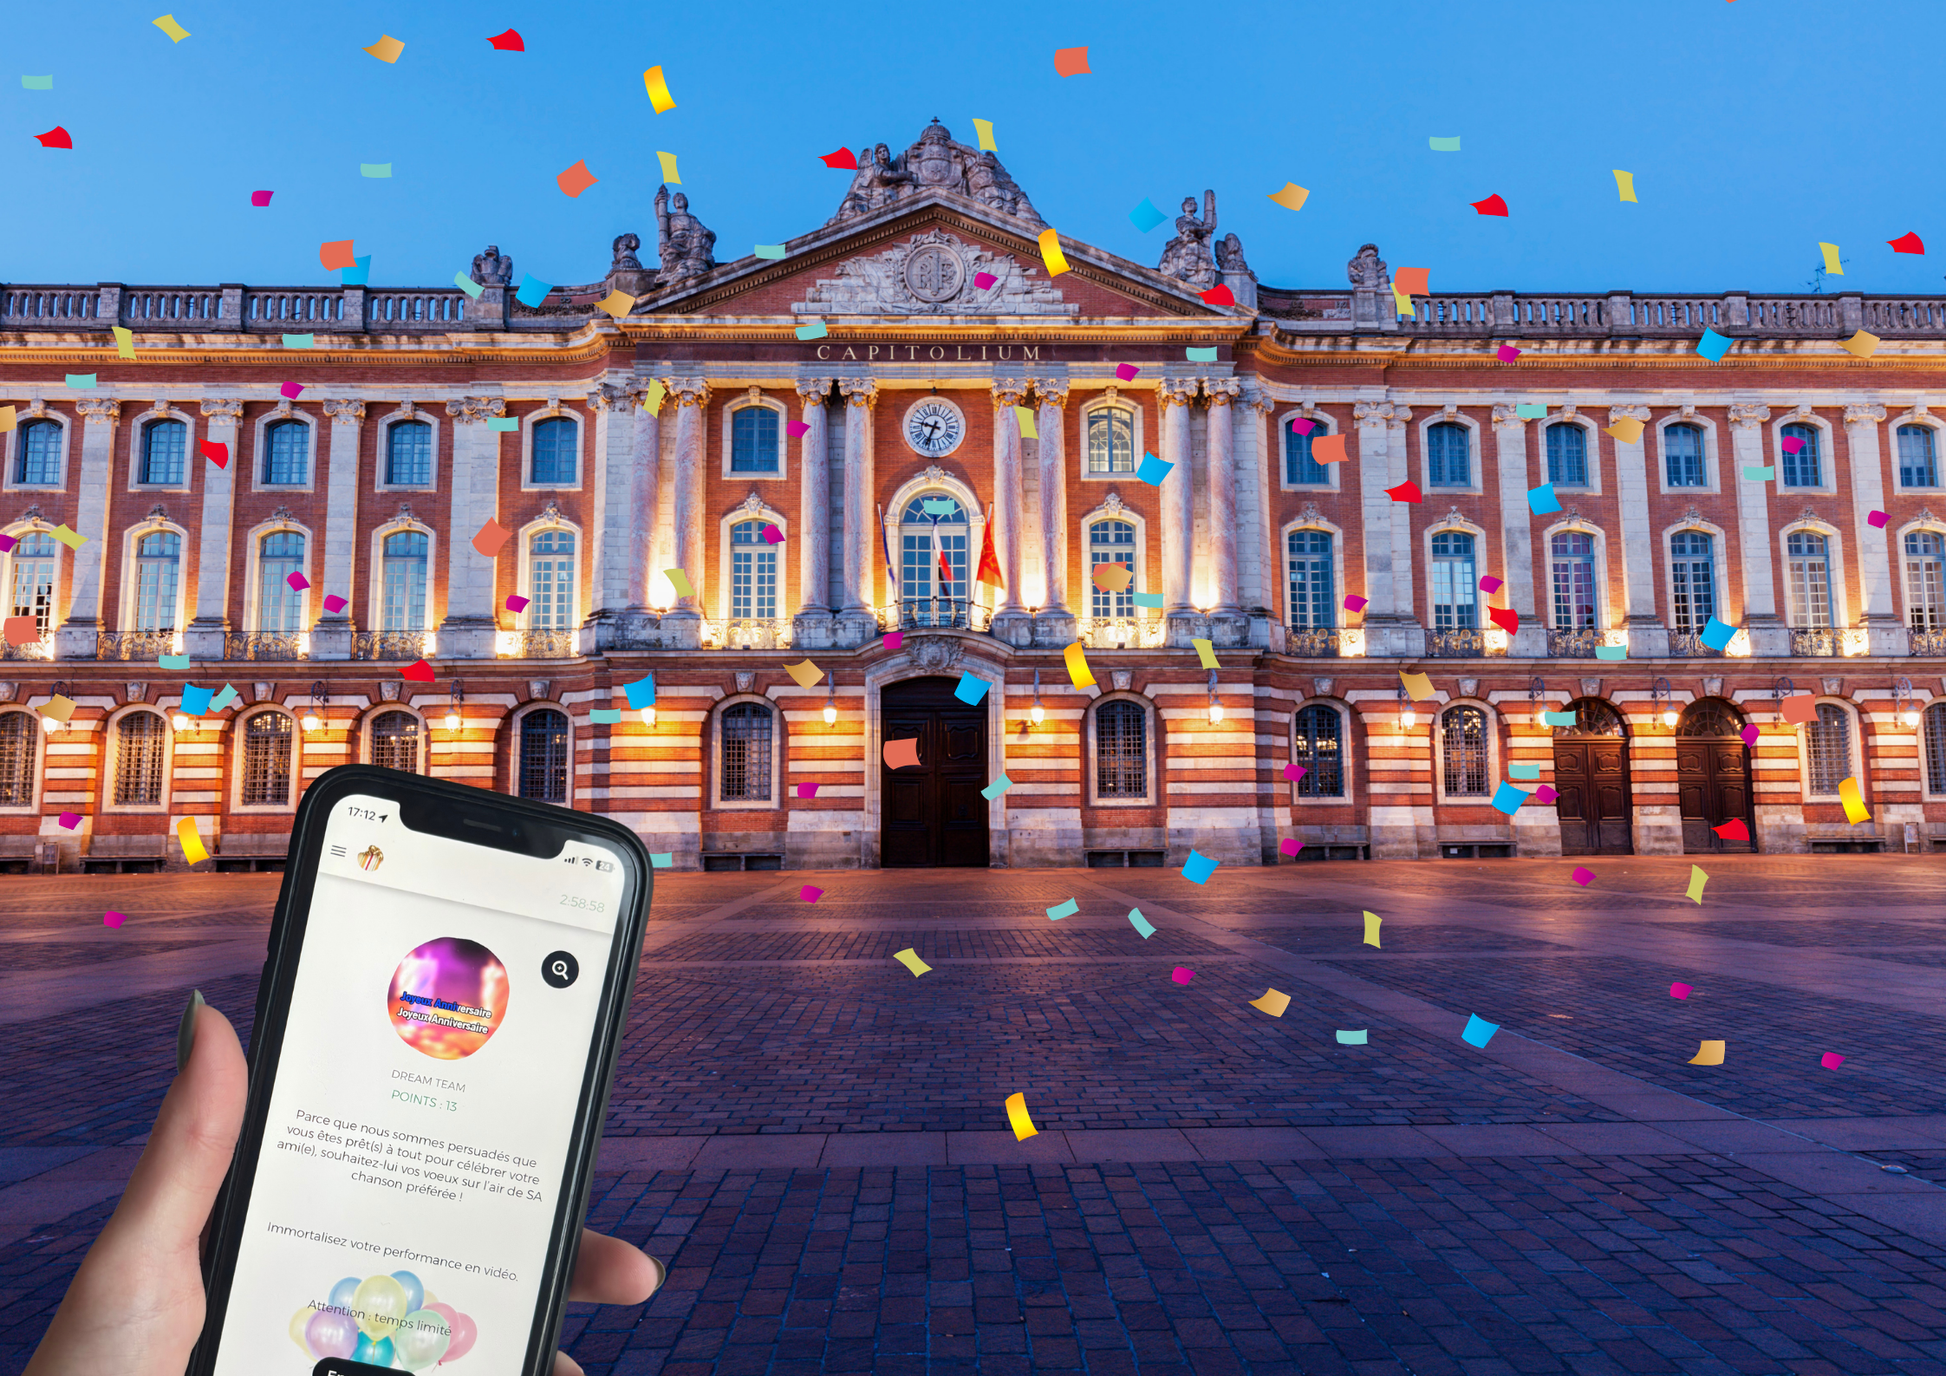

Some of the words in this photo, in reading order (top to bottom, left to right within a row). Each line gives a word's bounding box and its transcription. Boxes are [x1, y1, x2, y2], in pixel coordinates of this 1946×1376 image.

[817, 345, 1040, 361] CAPITOLIUM
[348, 806, 376, 821] 17:12
[599, 862, 611, 871] 24
[559, 894, 605, 913] 2:58:58
[400, 991, 433, 1007] Joyeux
[433, 998, 492, 1019] Anniversaire
[397, 1007, 430, 1022] Joyeux
[431, 1014, 489, 1034] Anniversaire
[392, 1070, 432, 1085] DREAM
[436, 1079, 466, 1093] TEAM
[392, 1090, 438, 1108] POINTS
[446, 1101, 458, 1112] 13
[296, 1110, 331, 1126] Parce
[333, 1120, 358, 1132] que
[361, 1125, 390, 1138] nous
[392, 1132, 445, 1149] sommes
[448, 1142, 511, 1163] persuadés
[513, 1157, 537, 1168] que
[287, 1126, 315, 1139] vous
[317, 1130, 343, 1145] êtes
[345, 1137, 383, 1155] prêt(s)
[386, 1144, 394, 1155] à
[397, 1147, 423, 1161] tout
[425, 1155, 455, 1167] pour
[456, 1160, 508, 1178] célébrer
[510, 1171, 540, 1186] votre
[277, 1141, 318, 1158] ami(e),
[321, 1150, 398, 1172] souhaitez-lui
[402, 1166, 421, 1177] vos
[424, 1170, 460, 1185] voeux
[462, 1179, 482, 1189] sur
[484, 1181, 506, 1194] l'air
[507, 1187, 524, 1198] de
[526, 1190, 543, 1203] SA
[351, 1171, 403, 1190] chanson
[406, 1183, 457, 1201] préférée
[268, 1222, 348, 1247] Immortalisez
[351, 1240, 381, 1254] votre
[383, 1247, 463, 1270] performance
[465, 1263, 481, 1274] en
[484, 1267, 519, 1282] vidéo.
[307, 1300, 366, 1320] Attention
[375, 1313, 414, 1329] temps
[417, 1320, 452, 1337] limité
